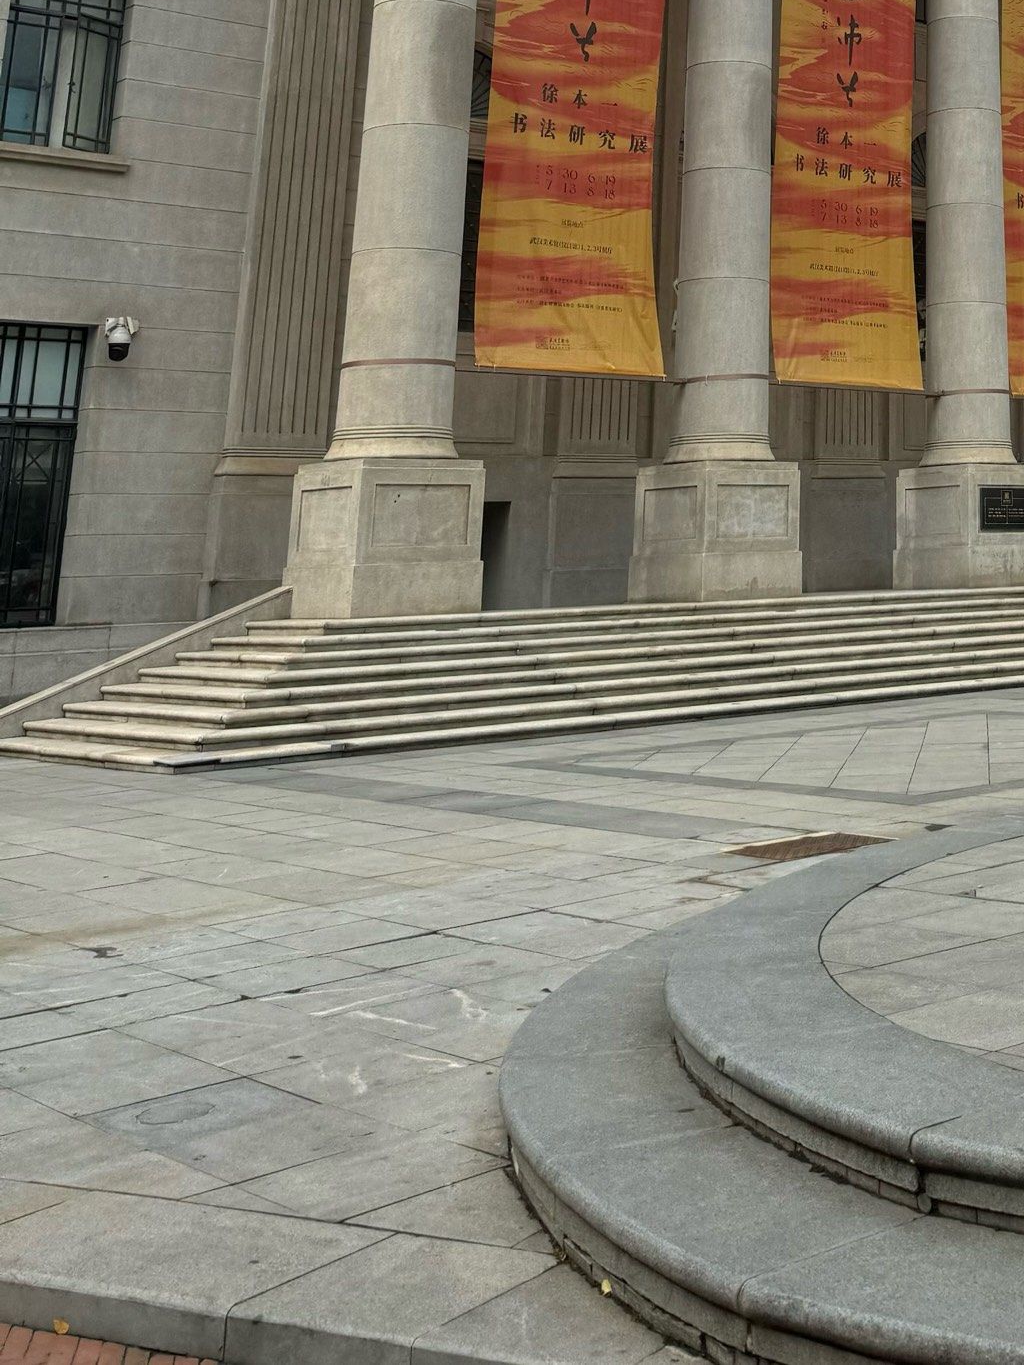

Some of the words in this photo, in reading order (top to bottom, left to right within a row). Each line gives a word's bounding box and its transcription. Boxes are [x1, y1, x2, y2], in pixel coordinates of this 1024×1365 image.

[541, 82, 618, 109] 徐本一
[509, 112, 649, 154] 书法研究展
[816, 126, 877, 149] 徐本一
[793, 153, 903, 188] 书法研究展
